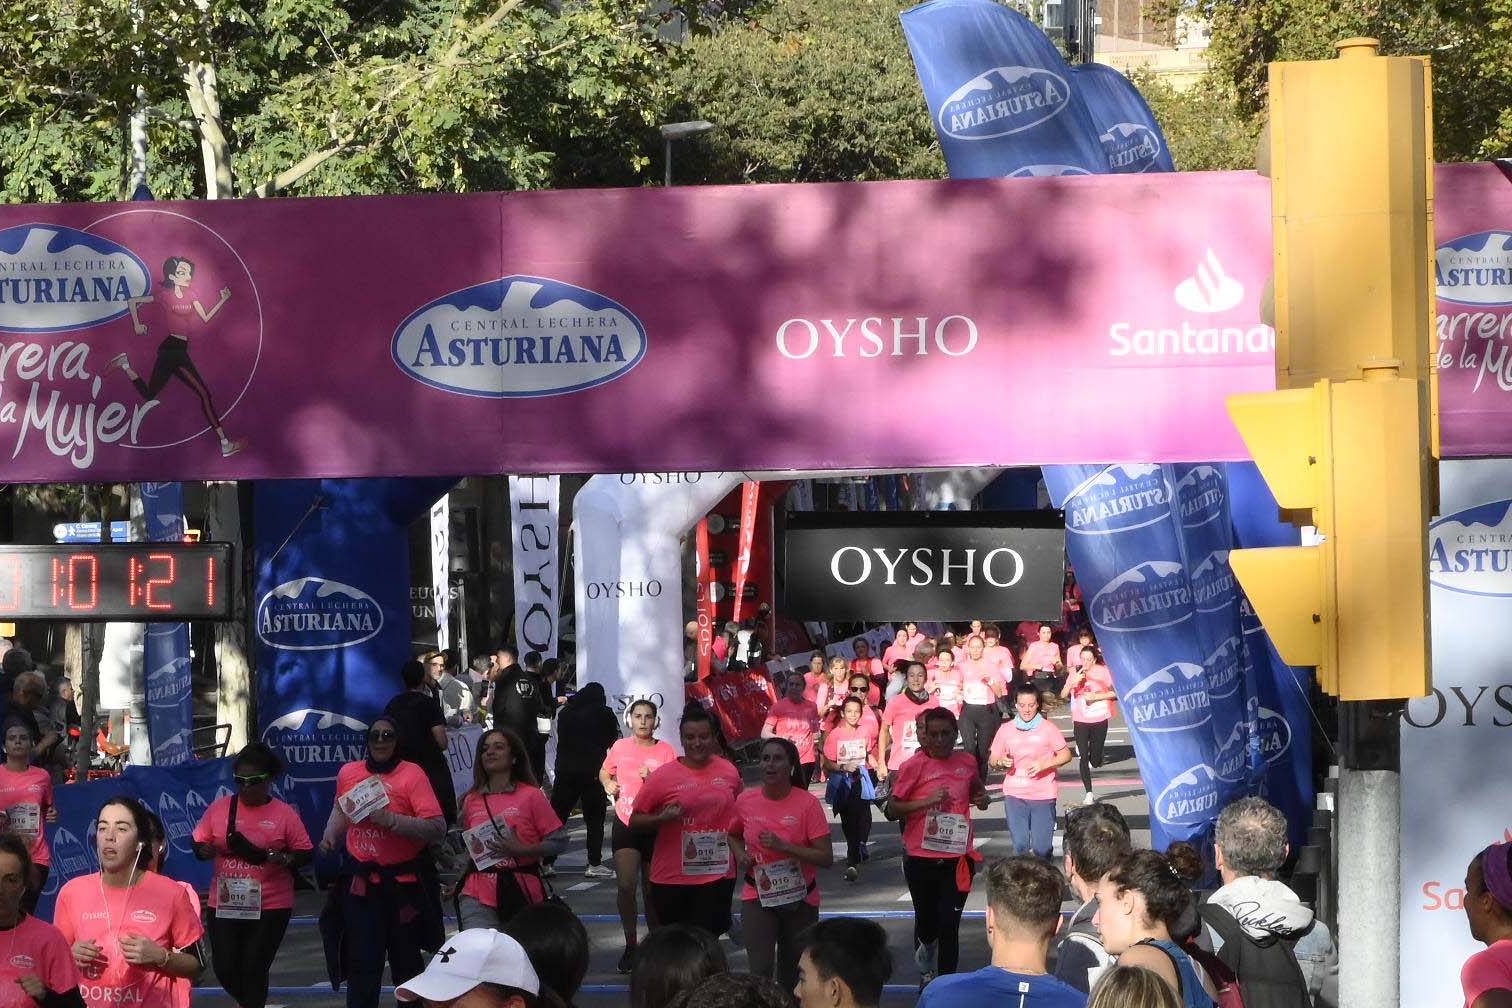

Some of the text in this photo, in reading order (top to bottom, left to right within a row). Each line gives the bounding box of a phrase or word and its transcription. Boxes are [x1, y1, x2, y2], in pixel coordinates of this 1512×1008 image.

[54, 260, 126, 271] LECHERA
[450, 316, 618, 331] CENTRAL LECHERA
[776, 315, 978, 359] OYSHO
[412, 323, 627, 368] ASTURIANA
[12, 375, 160, 468] Mujer
[830, 546, 1024, 587] OYSHO
[586, 580, 662, 600] OYSHO
[262, 607, 374, 634] ASTURIANA
[1402, 685, 1512, 729] OYS
[80, 984, 144, 1003] DORSAL
